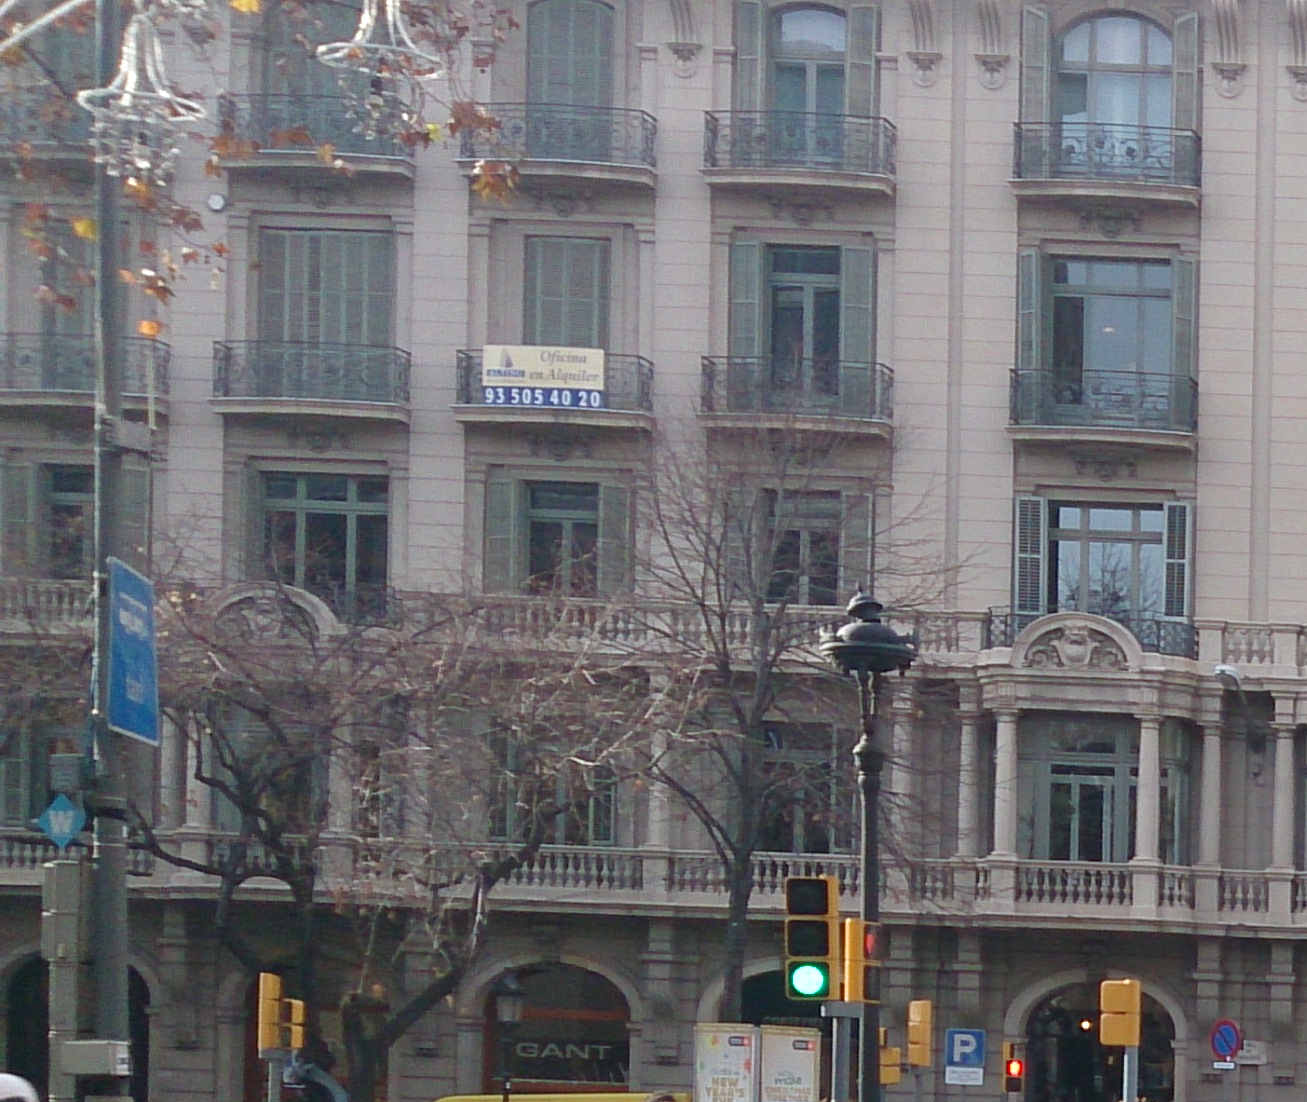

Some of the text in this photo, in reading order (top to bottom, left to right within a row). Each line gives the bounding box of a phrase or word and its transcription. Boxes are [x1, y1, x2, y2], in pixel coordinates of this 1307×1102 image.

[540, 350, 587, 365] Oficina
[529, 368, 599, 384] en Alquiler
[485, 388, 600, 407] 93 505 40 20
[516, 1042, 612, 1060] GANT
[953, 1033, 977, 1062] P
[711, 1077, 739, 1087] NEW
